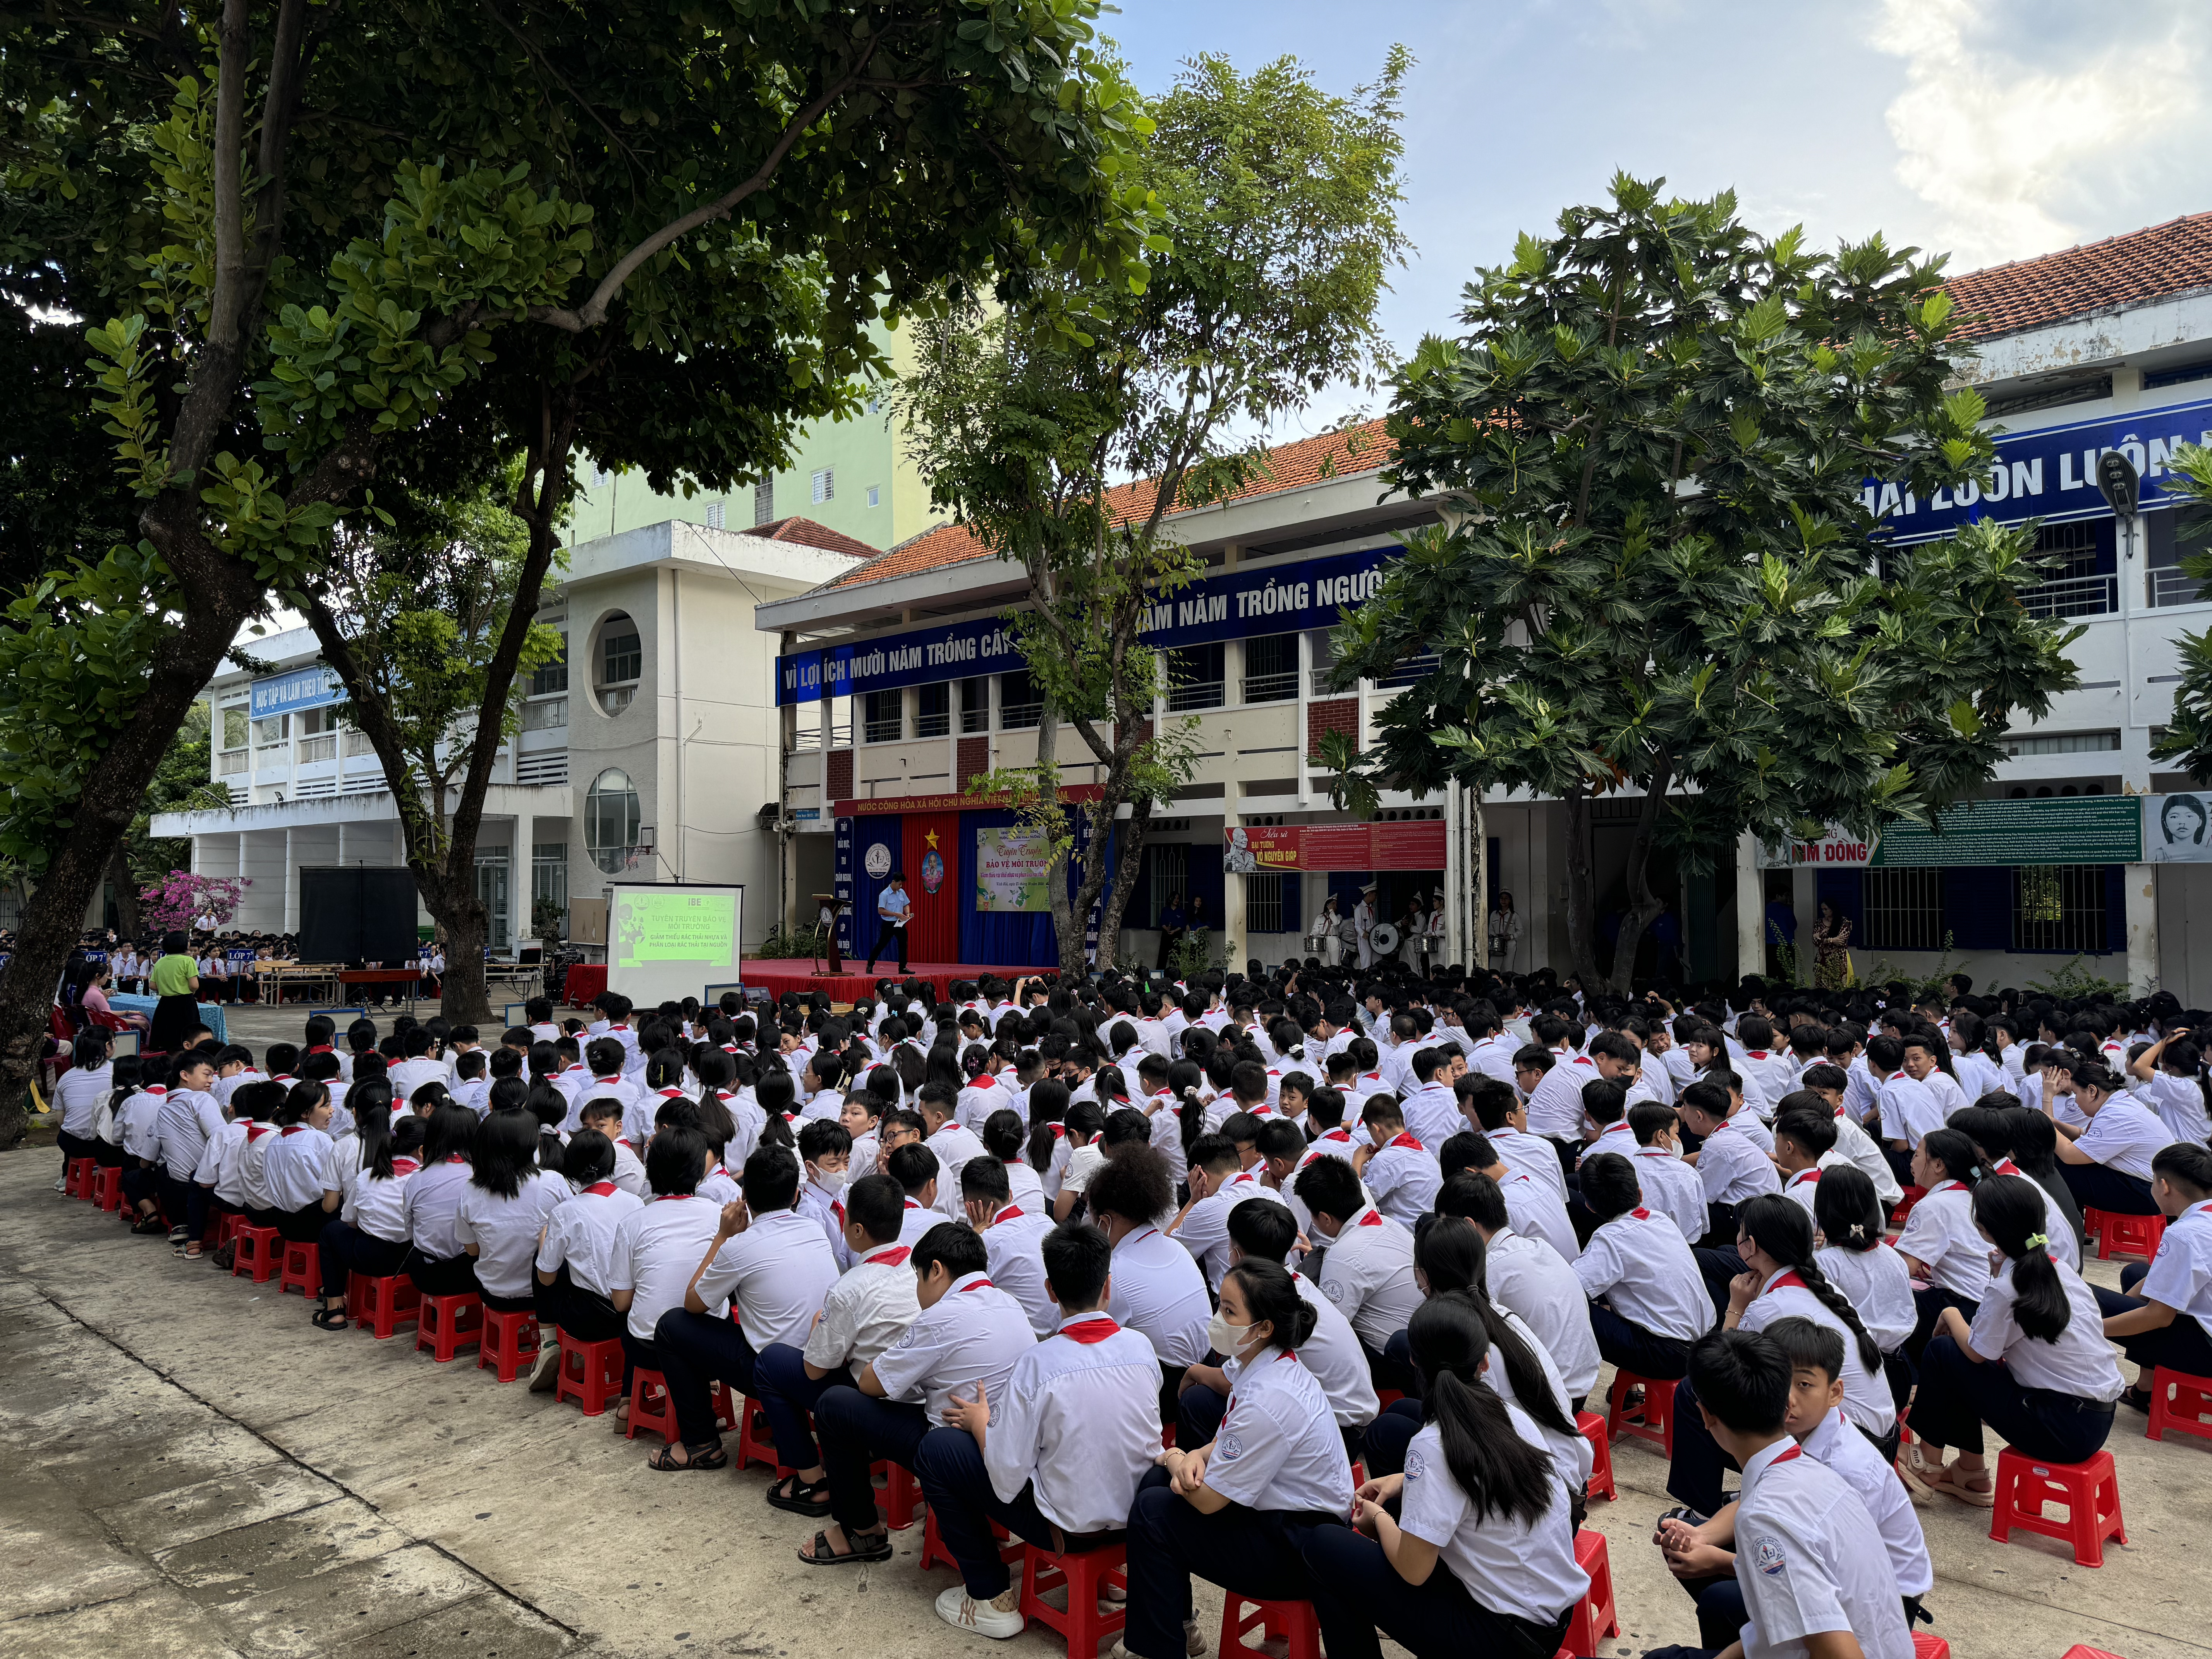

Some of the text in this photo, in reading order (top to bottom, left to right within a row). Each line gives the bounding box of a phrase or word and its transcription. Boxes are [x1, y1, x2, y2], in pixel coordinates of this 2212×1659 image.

[785, 664, 797, 689] VÌ
[801, 663, 820, 689] LỢI
[824, 658, 845, 683] ÍCH
[850, 648, 884, 678] MƯỜI
[889, 644, 922, 672] NĂM
[927, 633, 976, 666] TRỒNG
[1180, 592, 1227, 627] NĂM
[1237, 578, 1309, 618] TRỒNG
[1317, 564, 1385, 607] NGƯỜ
[256, 690, 267, 711] HỌC
[269, 684, 278, 709] TẬP
[280, 681, 286, 703] VÀ
[288, 679, 300, 701] LÀM
[302, 678, 316, 699] THEO
[858, 800, 877, 811] NƯỚC
[878, 800, 898, 812] CỘNG
[900, 798, 915, 809] HÒA
[917, 798, 926, 808] XÃ
[929, 797, 941, 810] HỘI
[943, 795, 958, 807] CHỦ
[960, 795, 984, 806] NGHĨA
[997, 845, 1017, 858] Tuyên
[1257, 847, 1297, 862] VÕ NGUYÊN GIÁP
[1824, 838, 1867, 861] ĐỒNG
[986, 859, 1048, 869] BẢO VỆ MÔI TRƯỜN
[86, 952, 97, 962] ỚP
[229, 951, 245, 959] LỚP
